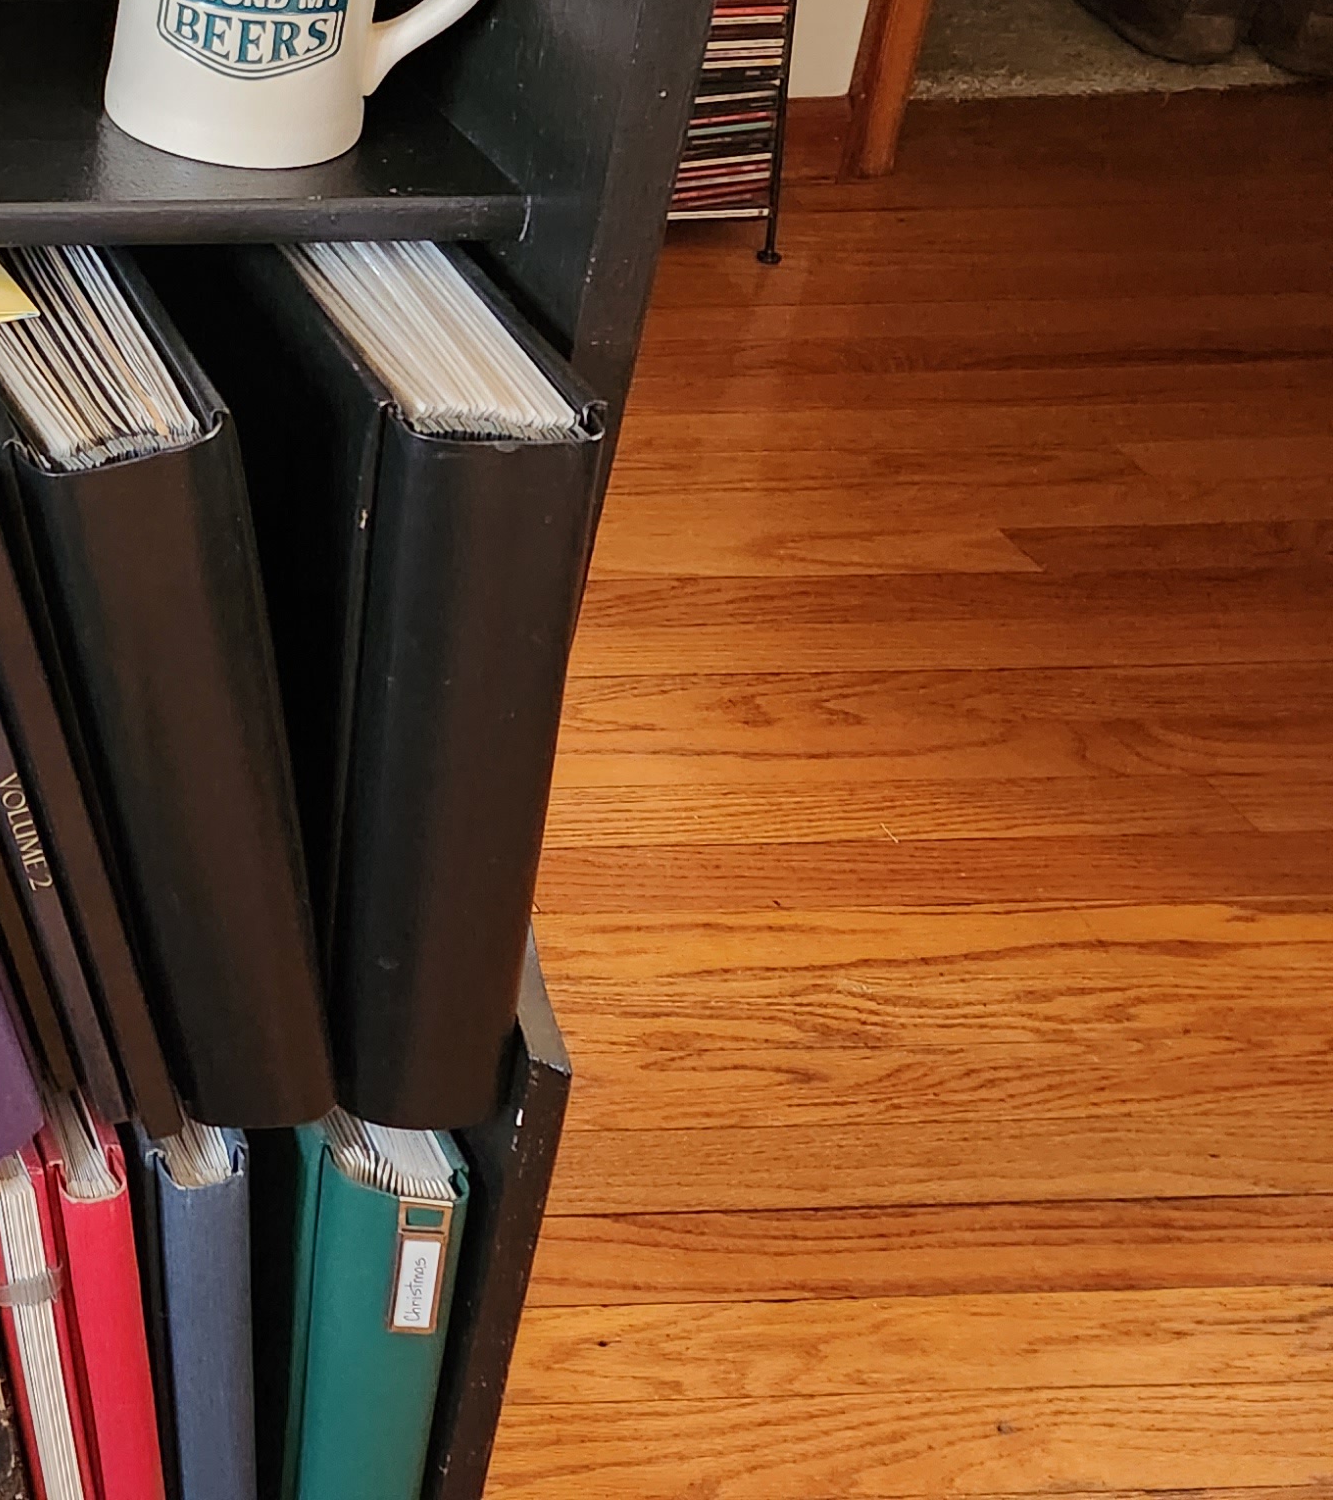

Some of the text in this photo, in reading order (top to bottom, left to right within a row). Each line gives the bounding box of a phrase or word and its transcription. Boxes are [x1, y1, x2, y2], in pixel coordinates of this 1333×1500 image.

[173, 1, 330, 64] BEERS
[28, 875, 53, 892] 2
[403, 1257, 427, 1321] Christmas
